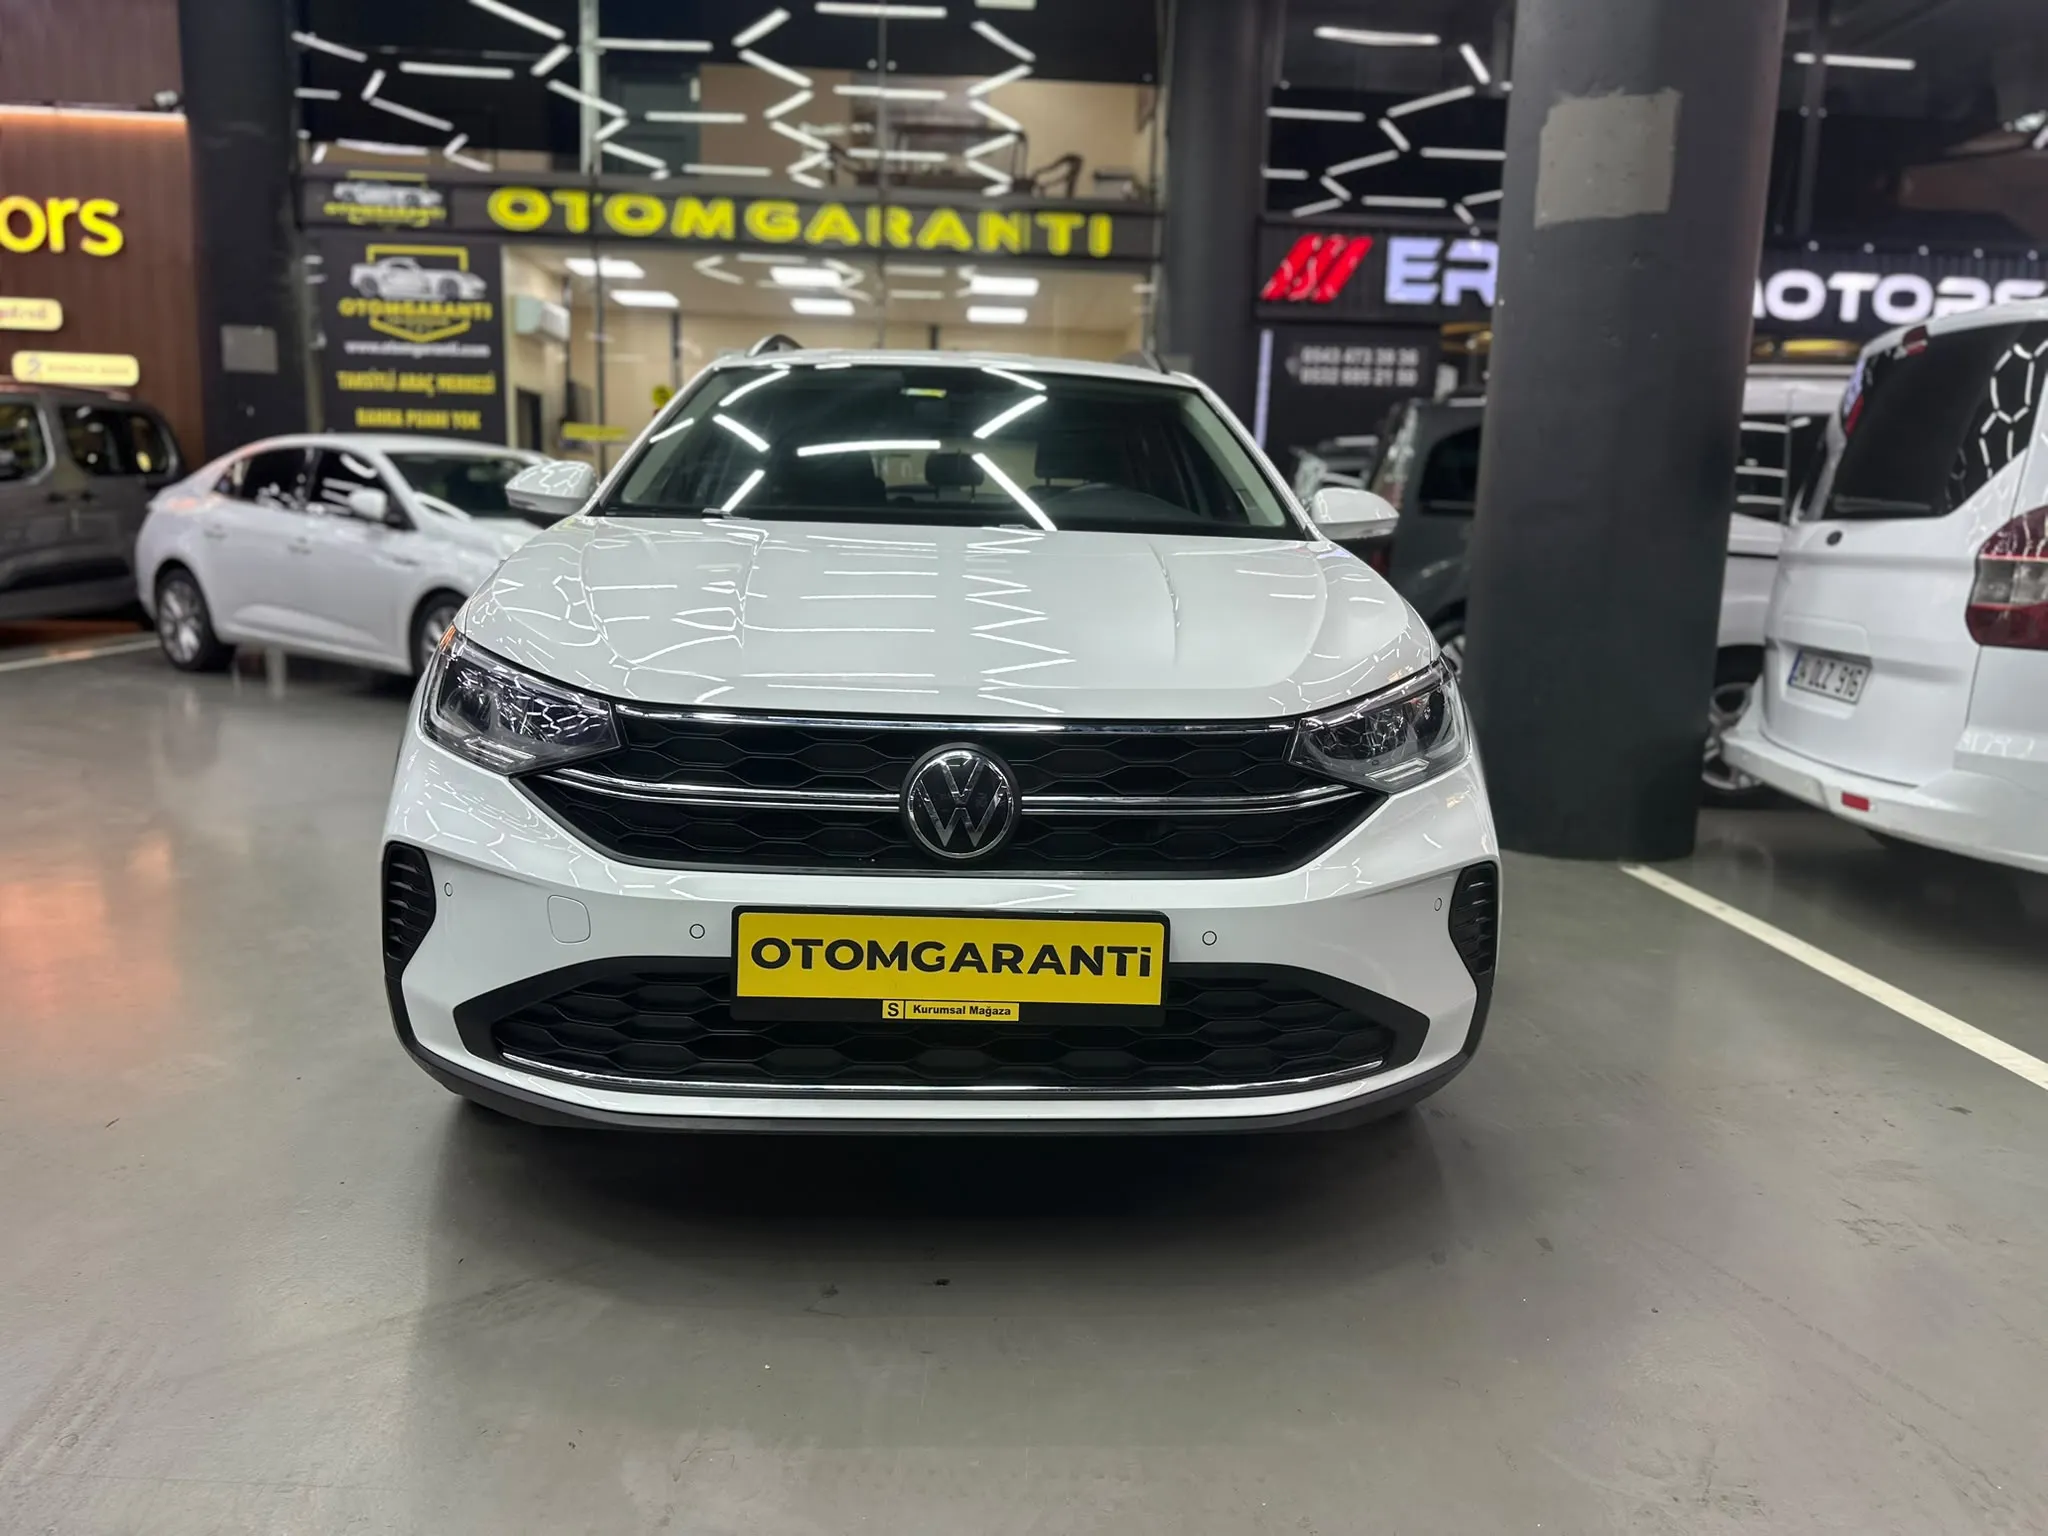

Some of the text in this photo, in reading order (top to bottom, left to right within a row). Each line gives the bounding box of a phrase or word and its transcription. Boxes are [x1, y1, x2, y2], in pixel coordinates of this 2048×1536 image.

[487, 186, 1112, 257] OTOMGARANTI
[1752, 269, 2047, 324] OTOR
[913, 1005, 966, 1017] Kurumsal
[969, 1006, 1011, 1018] Mağaza
